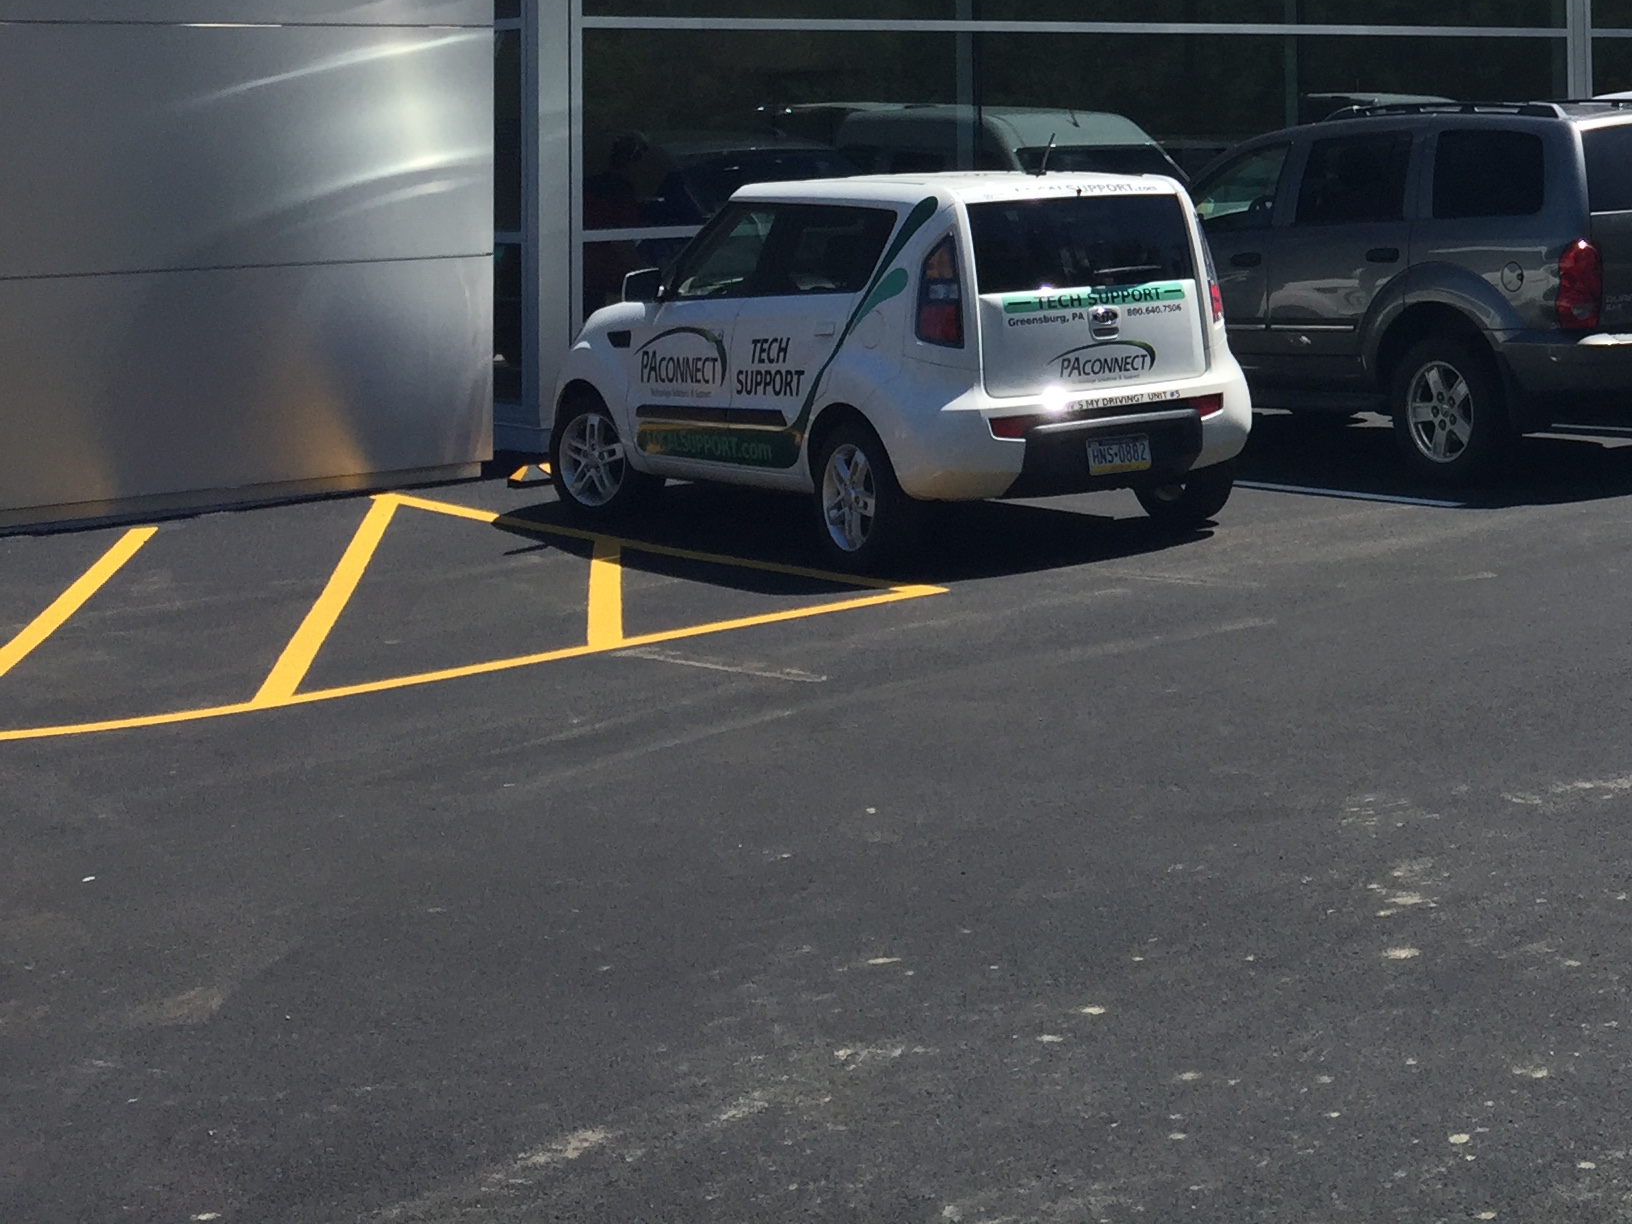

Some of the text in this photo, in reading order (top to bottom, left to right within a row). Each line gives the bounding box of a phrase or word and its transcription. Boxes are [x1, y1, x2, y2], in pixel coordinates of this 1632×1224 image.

[1034, 287, 1161, 310] TECH SUPPORT
[1008, 312, 1085, 327] Greensburg, PA
[751, 337, 790, 364] TECH
[641, 350, 718, 384] PACONNECT
[1060, 354, 1148, 377] PACONNECT
[736, 370, 805, 397] SUPPORT
[1086, 398, 1100, 409] MY
[1102, 394, 1144, 406] DRIVING?
[1148, 391, 1168, 401] UNIT
